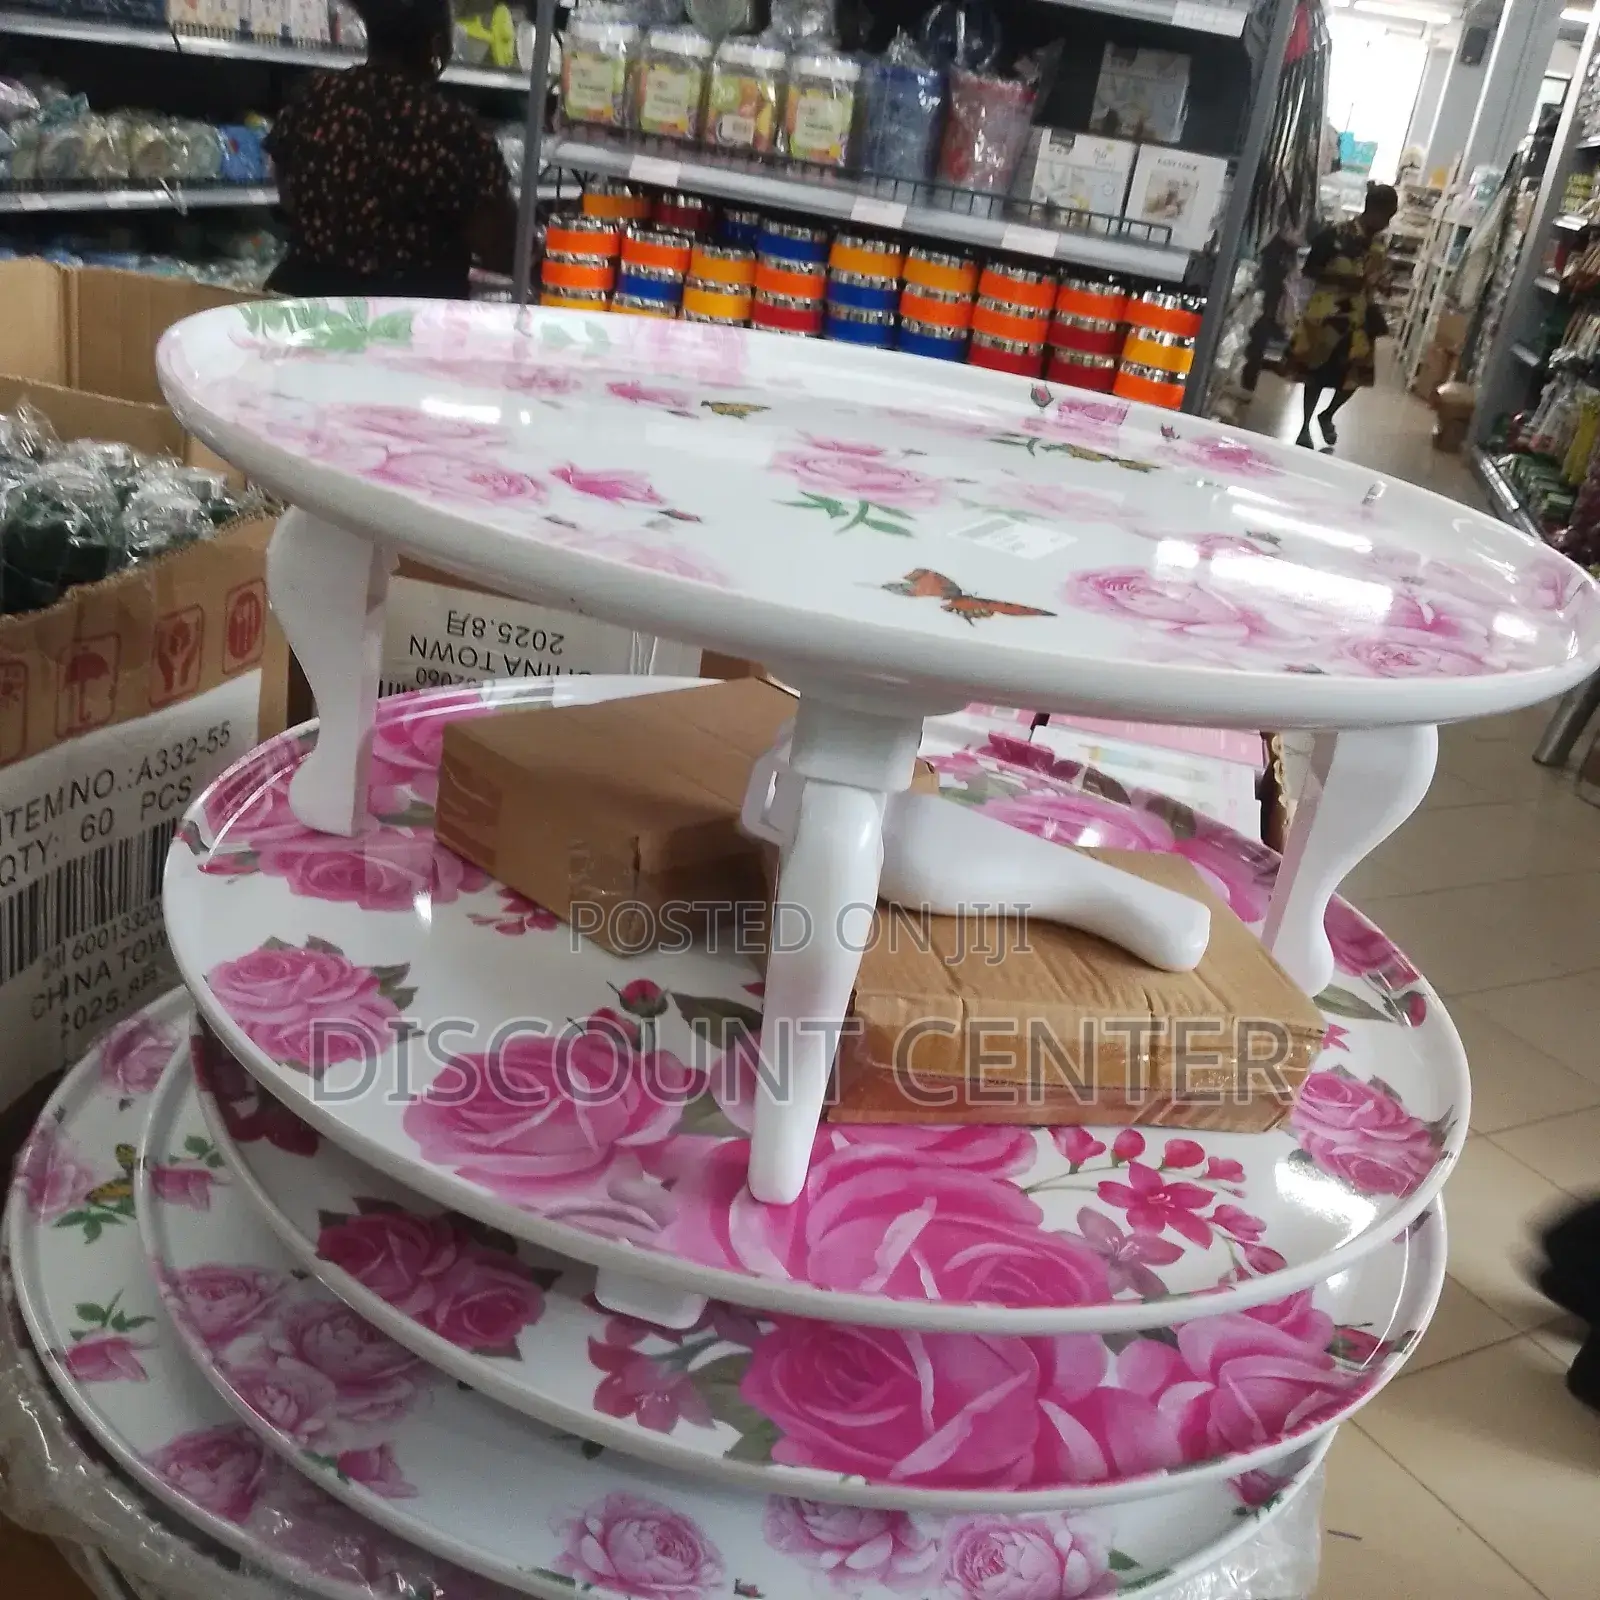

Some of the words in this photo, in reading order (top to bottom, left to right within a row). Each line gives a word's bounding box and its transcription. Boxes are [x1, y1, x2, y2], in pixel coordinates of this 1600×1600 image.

[409, 635, 495, 675] TOWN
[446, 610, 565, 656] 2025.8月
[0, 831, 60, 888] QTY:
[80, 807, 114, 843] 60
[139, 775, 193, 822] PCS
[30, 960, 112, 1021] CHINA
